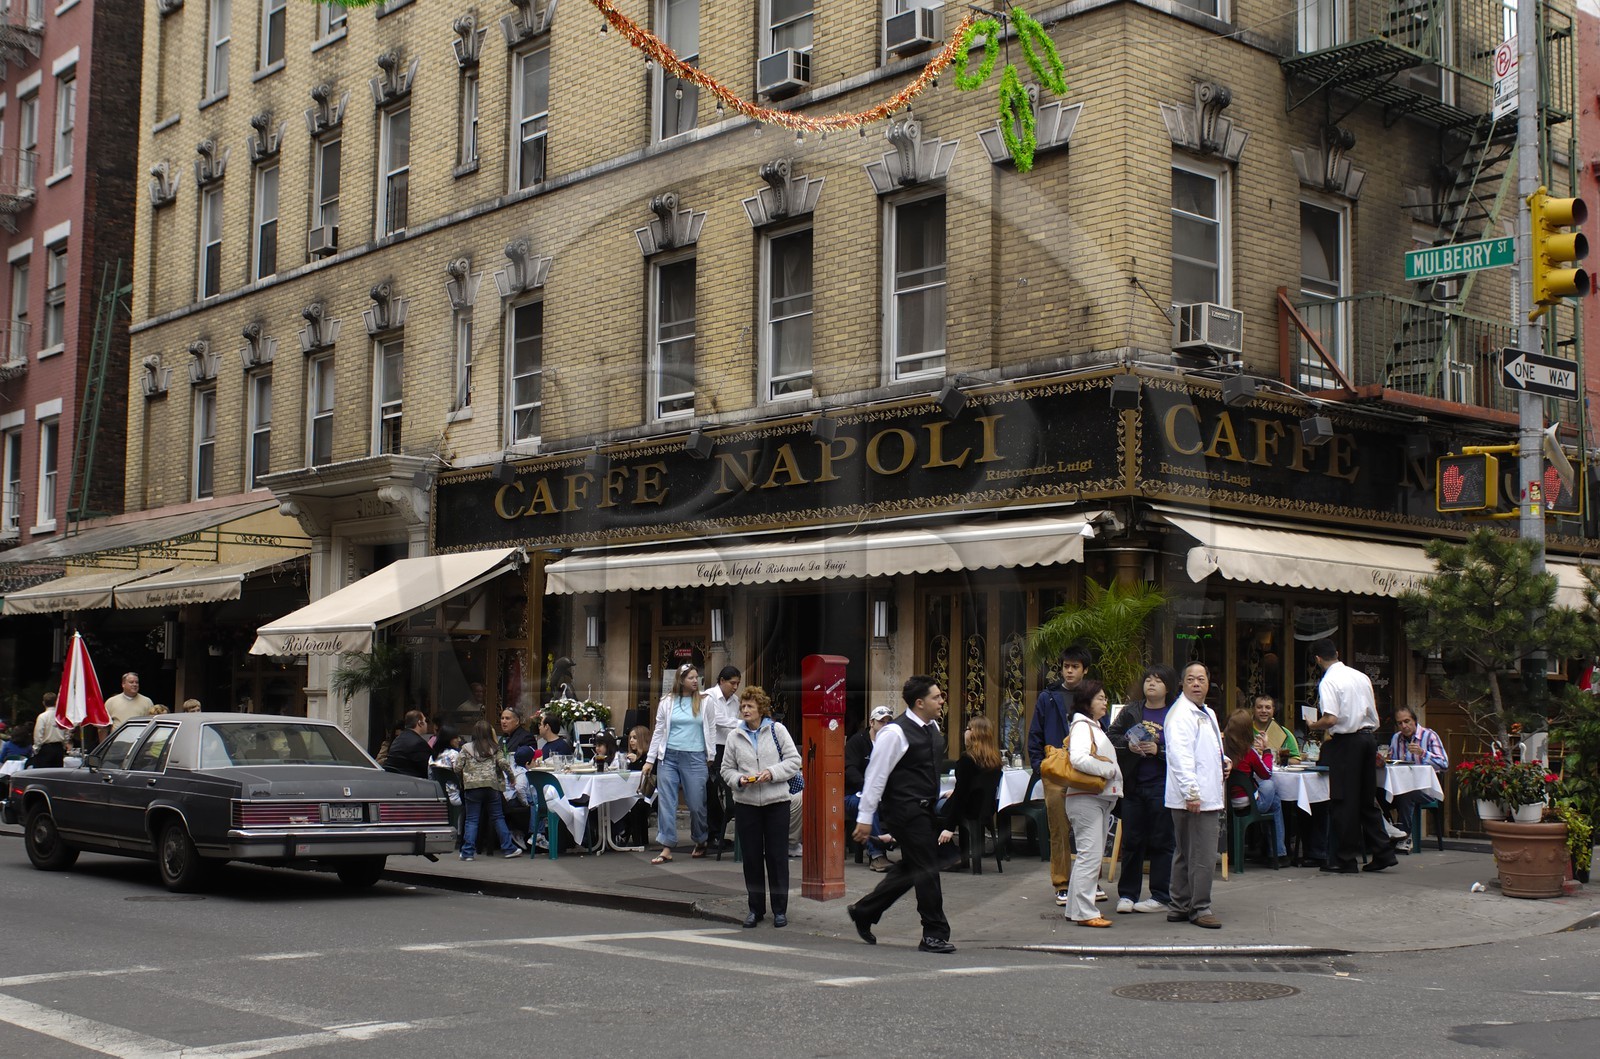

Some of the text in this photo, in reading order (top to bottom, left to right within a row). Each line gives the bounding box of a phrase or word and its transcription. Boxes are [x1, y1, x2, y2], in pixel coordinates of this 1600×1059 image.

[1413, 241, 1508, 276] MULBERRY ST
[1515, 362, 1570, 387] ONE WAY
[1164, 403, 1360, 484] CAFFE
[494, 414, 1005, 520] CAFFE NAPOLI
[985, 459, 1094, 482] Ristorante Luigi
[1159, 462, 1251, 487] Ristorante Luigi
[697, 564, 723, 582] Caffe
[726, 561, 762, 580] Napoli
[824, 559, 848, 573] Luigi
[1371, 569, 1398, 592] Caffe
[282, 635, 343, 652] Ristorante
